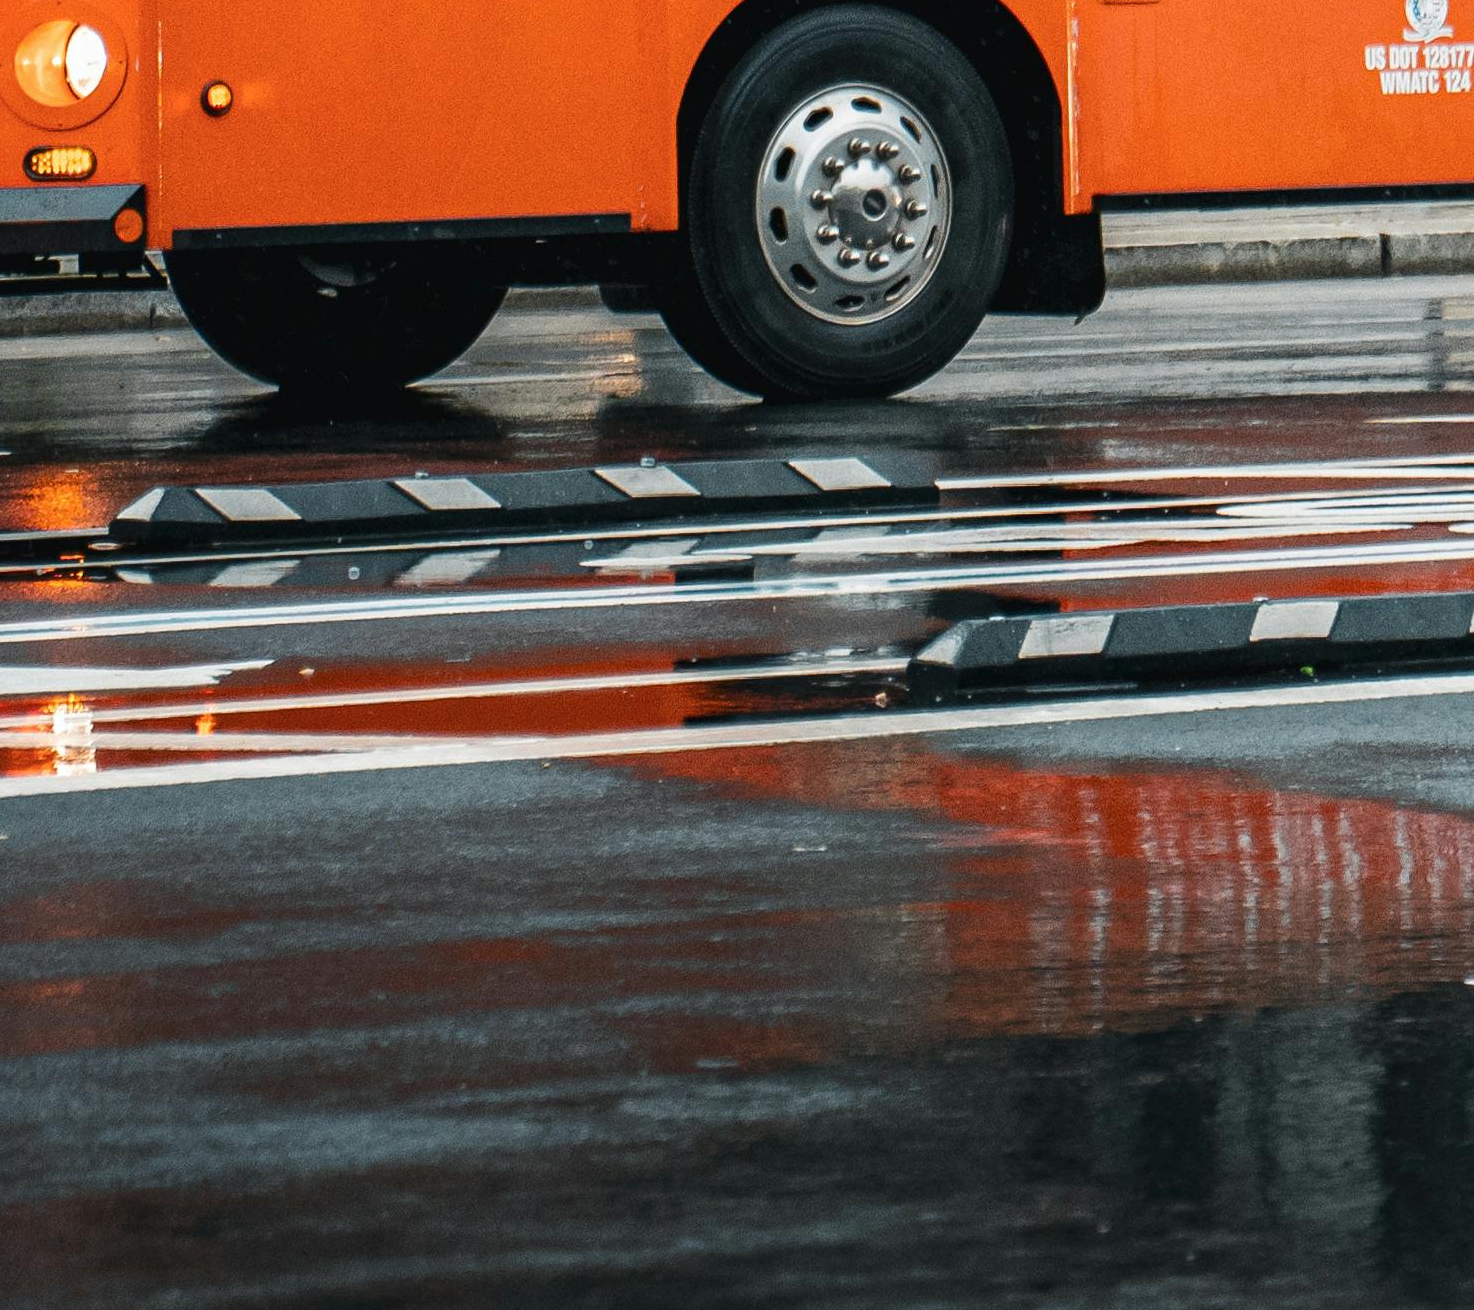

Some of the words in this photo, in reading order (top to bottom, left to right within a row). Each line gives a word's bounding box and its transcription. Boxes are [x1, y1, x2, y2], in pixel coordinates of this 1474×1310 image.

[1365, 45, 1386, 70] US
[1389, 44, 1419, 69] DOT
[1380, 69, 1440, 94] WMATC
[1444, 69, 1471, 93] 124
